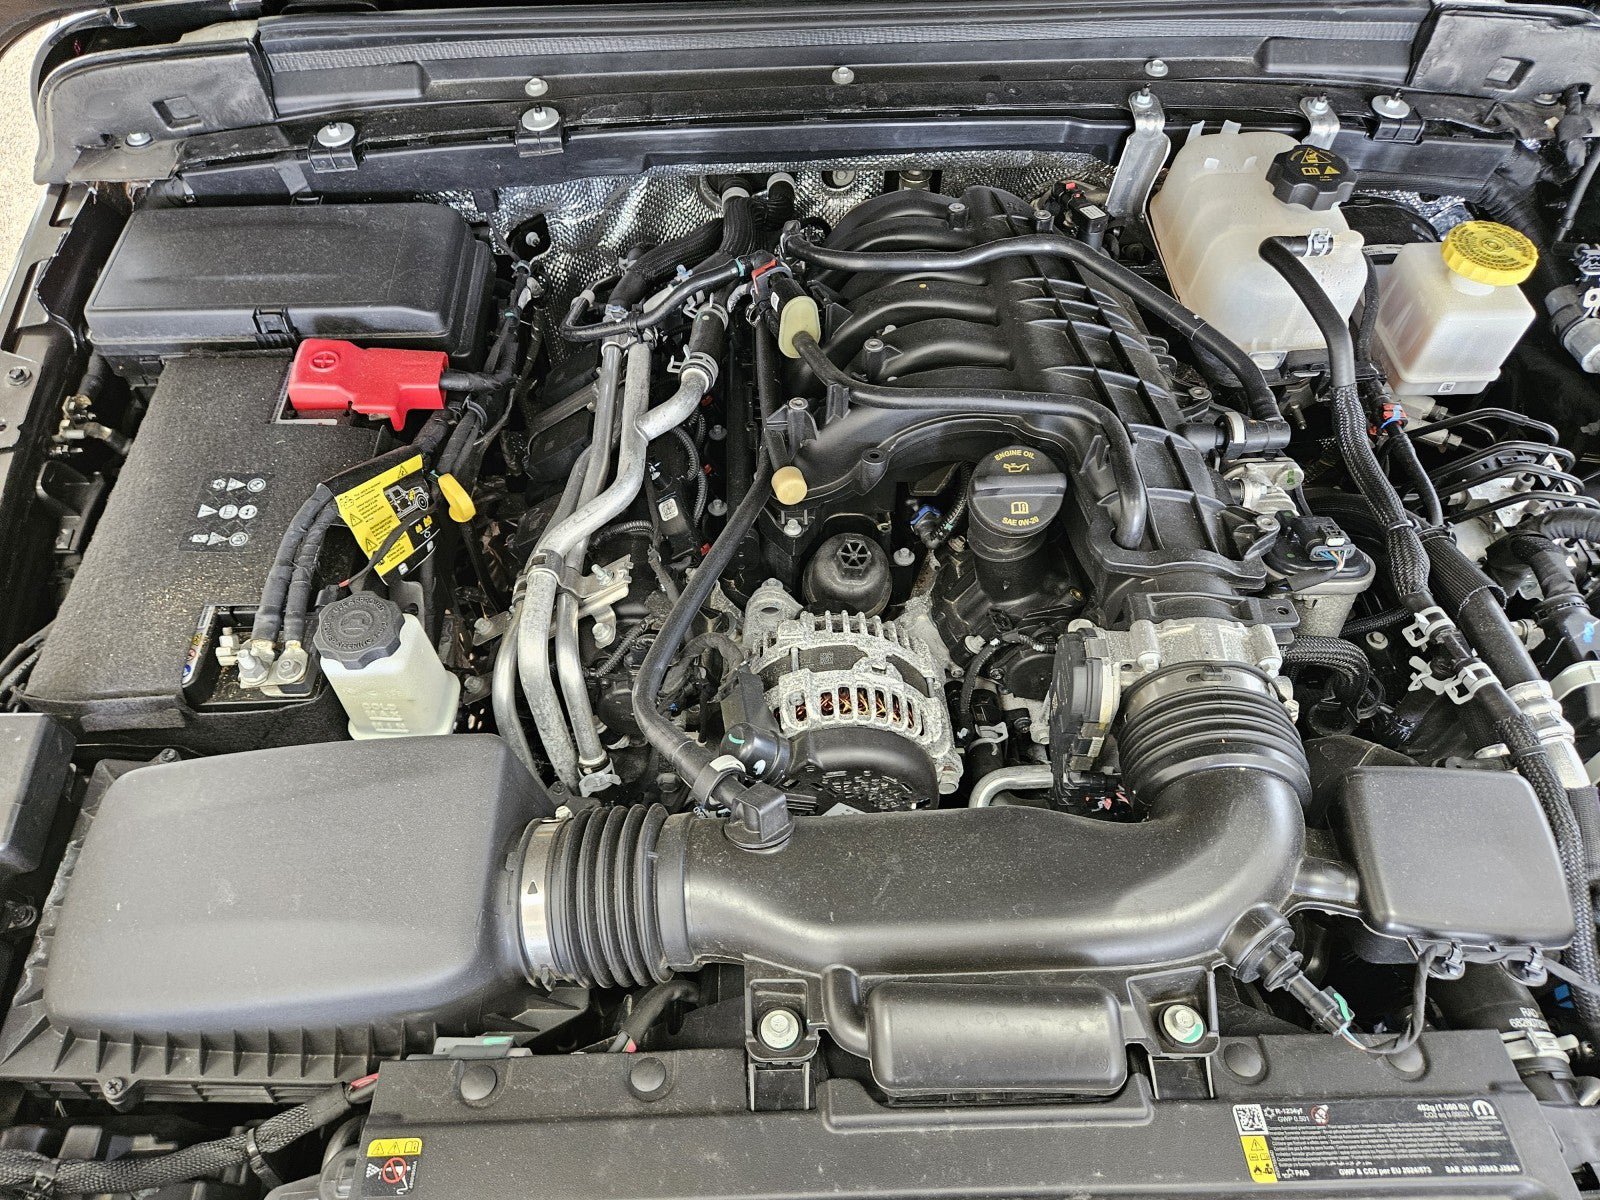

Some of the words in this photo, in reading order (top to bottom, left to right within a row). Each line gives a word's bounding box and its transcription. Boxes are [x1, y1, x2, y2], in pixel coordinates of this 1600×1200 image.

[994, 450, 1022, 461] ENGINE
[1023, 451, 1035, 460] OIL
[1001, 516, 1018, 525] SAE
[1018, 515, 1039, 527] 0W-20
